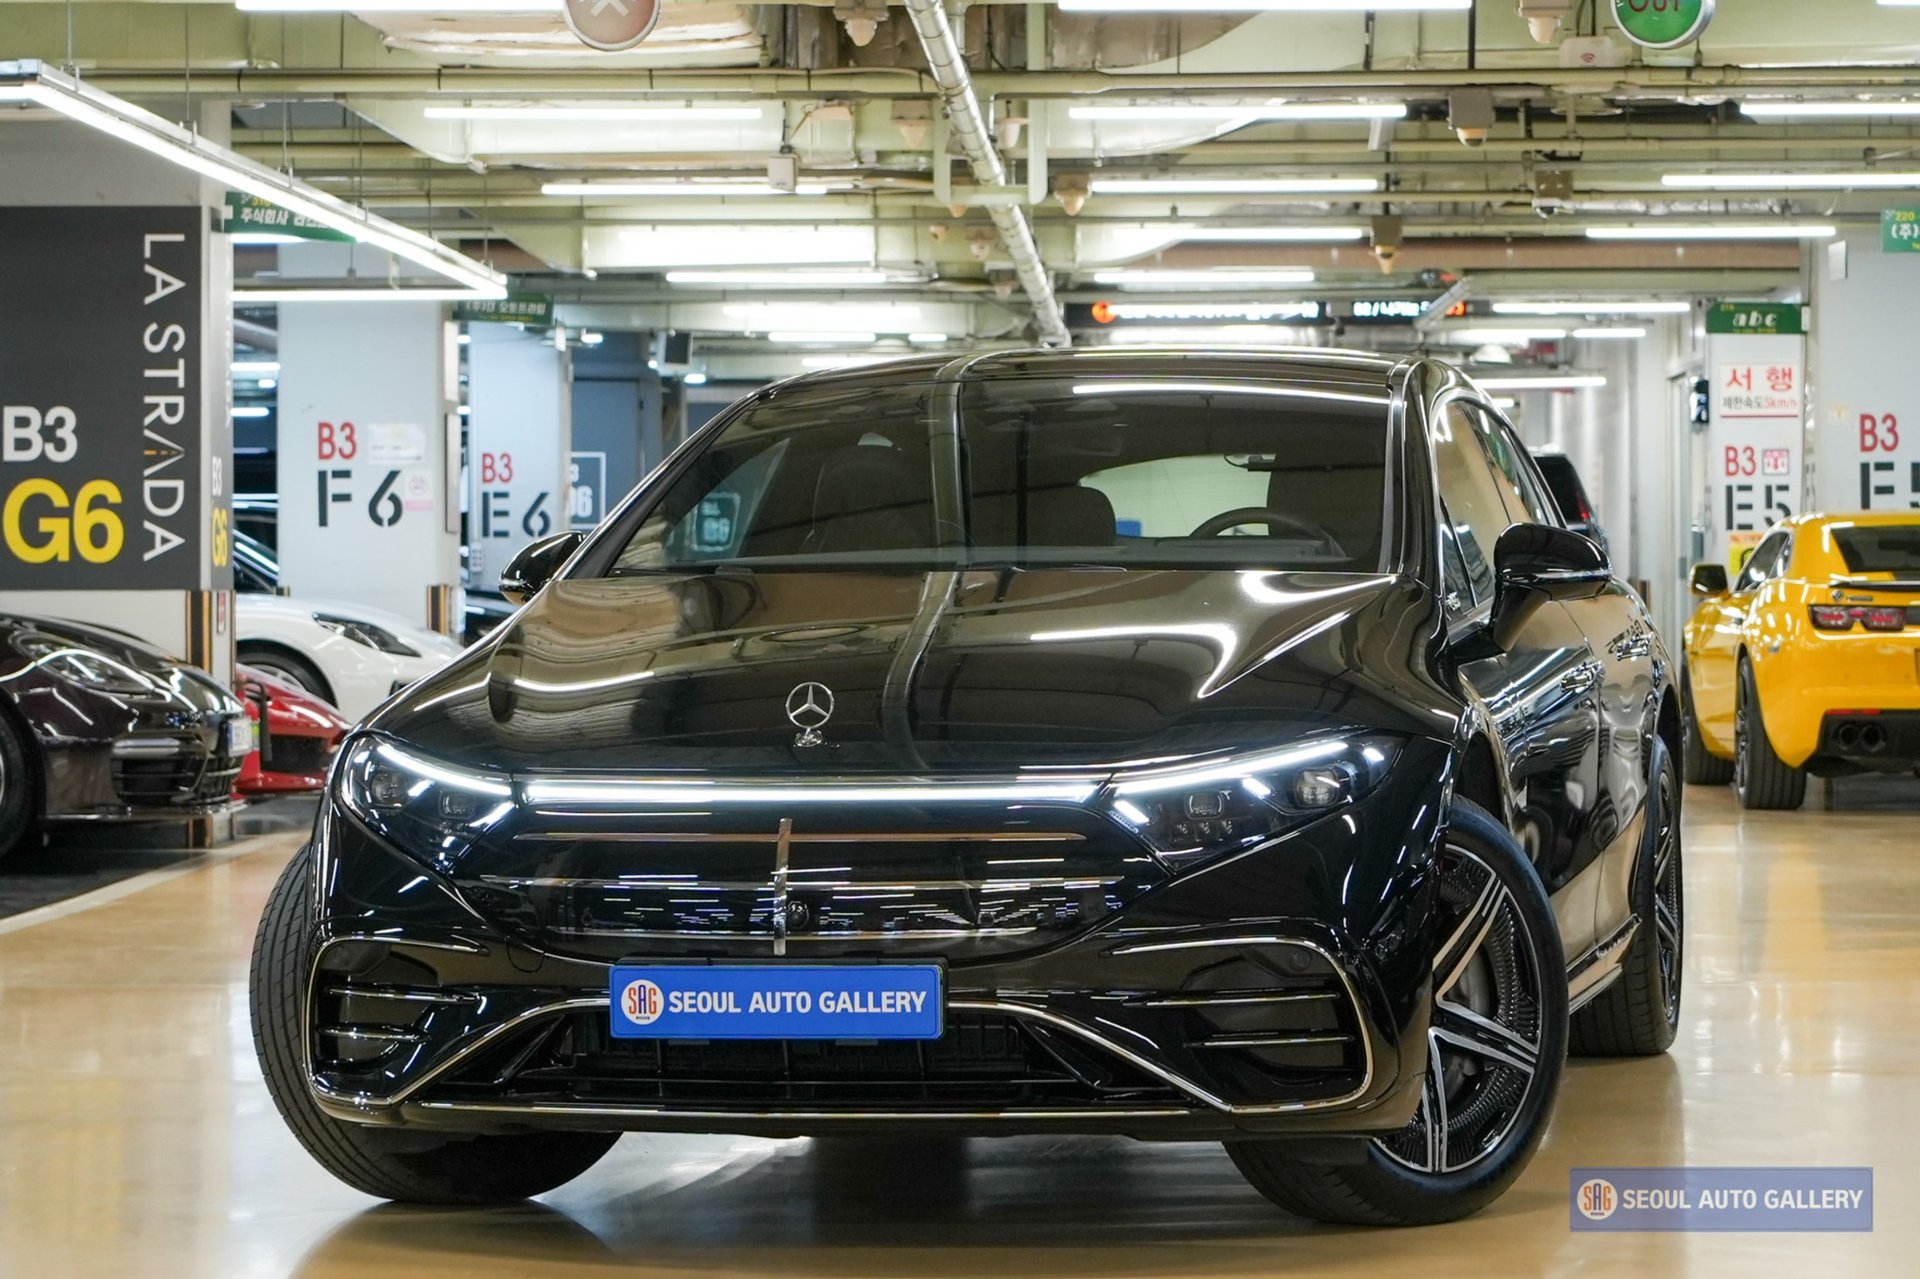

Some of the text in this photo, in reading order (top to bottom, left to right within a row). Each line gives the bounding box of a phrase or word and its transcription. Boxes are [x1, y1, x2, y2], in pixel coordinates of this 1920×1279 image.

[241, 207, 289, 226] 주식회사
[1895, 210, 1915, 221] 220
[1732, 310, 1777, 328] abc
[143, 233, 185, 562] LA STRADA
[2, 406, 78, 462] B3
[318, 422, 357, 459] B3
[1859, 413, 1899, 452] B3
[482, 453, 513, 483] B3
[1725, 446, 1757, 476] B3
[2, 478, 124, 563] G6
[628, 984, 927, 1015] SAG SEOUL AUTO GALLERY
